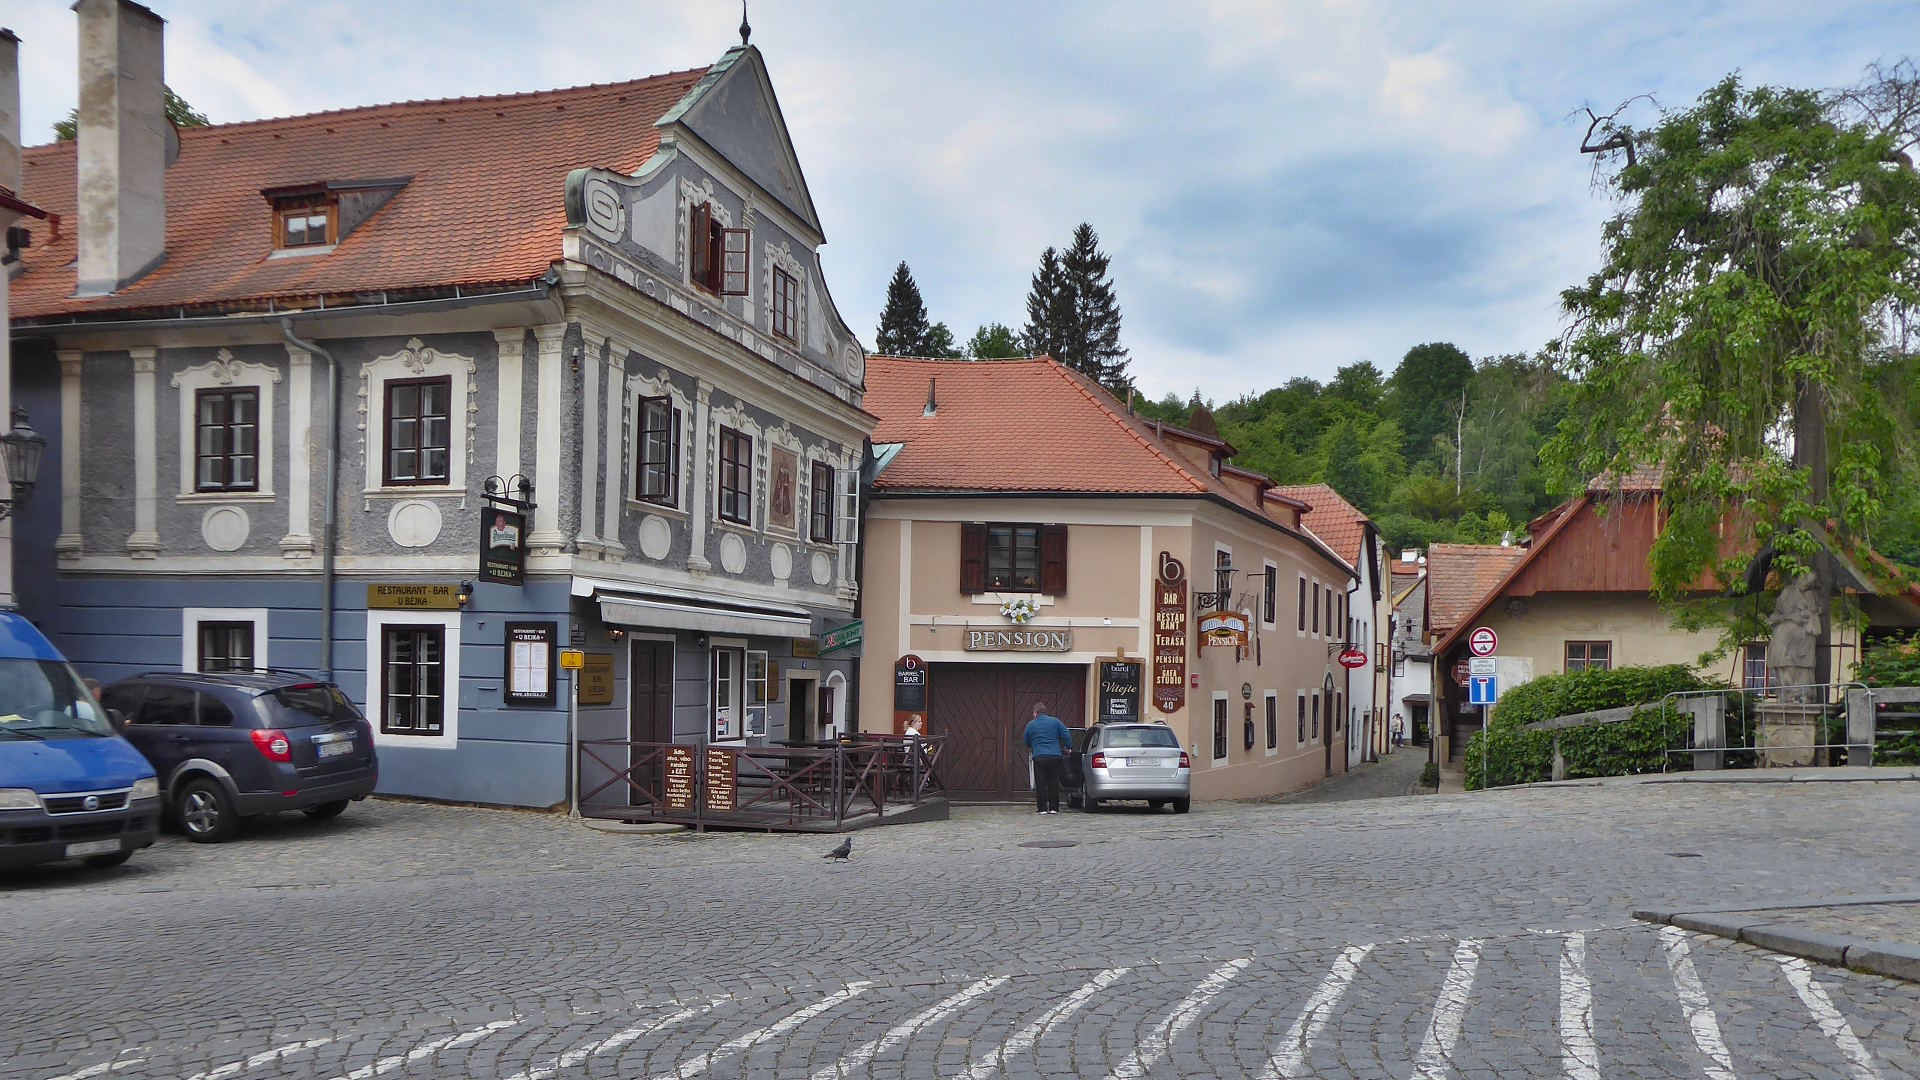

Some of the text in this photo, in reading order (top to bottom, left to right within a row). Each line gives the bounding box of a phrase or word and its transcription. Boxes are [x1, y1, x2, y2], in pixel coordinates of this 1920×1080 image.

[377, 586, 449, 595] RESTAURANT BAR
[397, 597, 428, 605] U BEJKA
[1163, 592, 1178, 605] BAR
[1156, 612, 1185, 622] RESTAU
[1160, 621, 1180, 630] RANT
[969, 631, 1066, 650] PENSION
[1155, 633, 1185, 646] TERASA
[1207, 633, 1239, 646] PENSION
[1155, 655, 1184, 664] PENSION
[1156, 676, 1182, 685] STUDIO
[1162, 701, 1174, 710] 40
